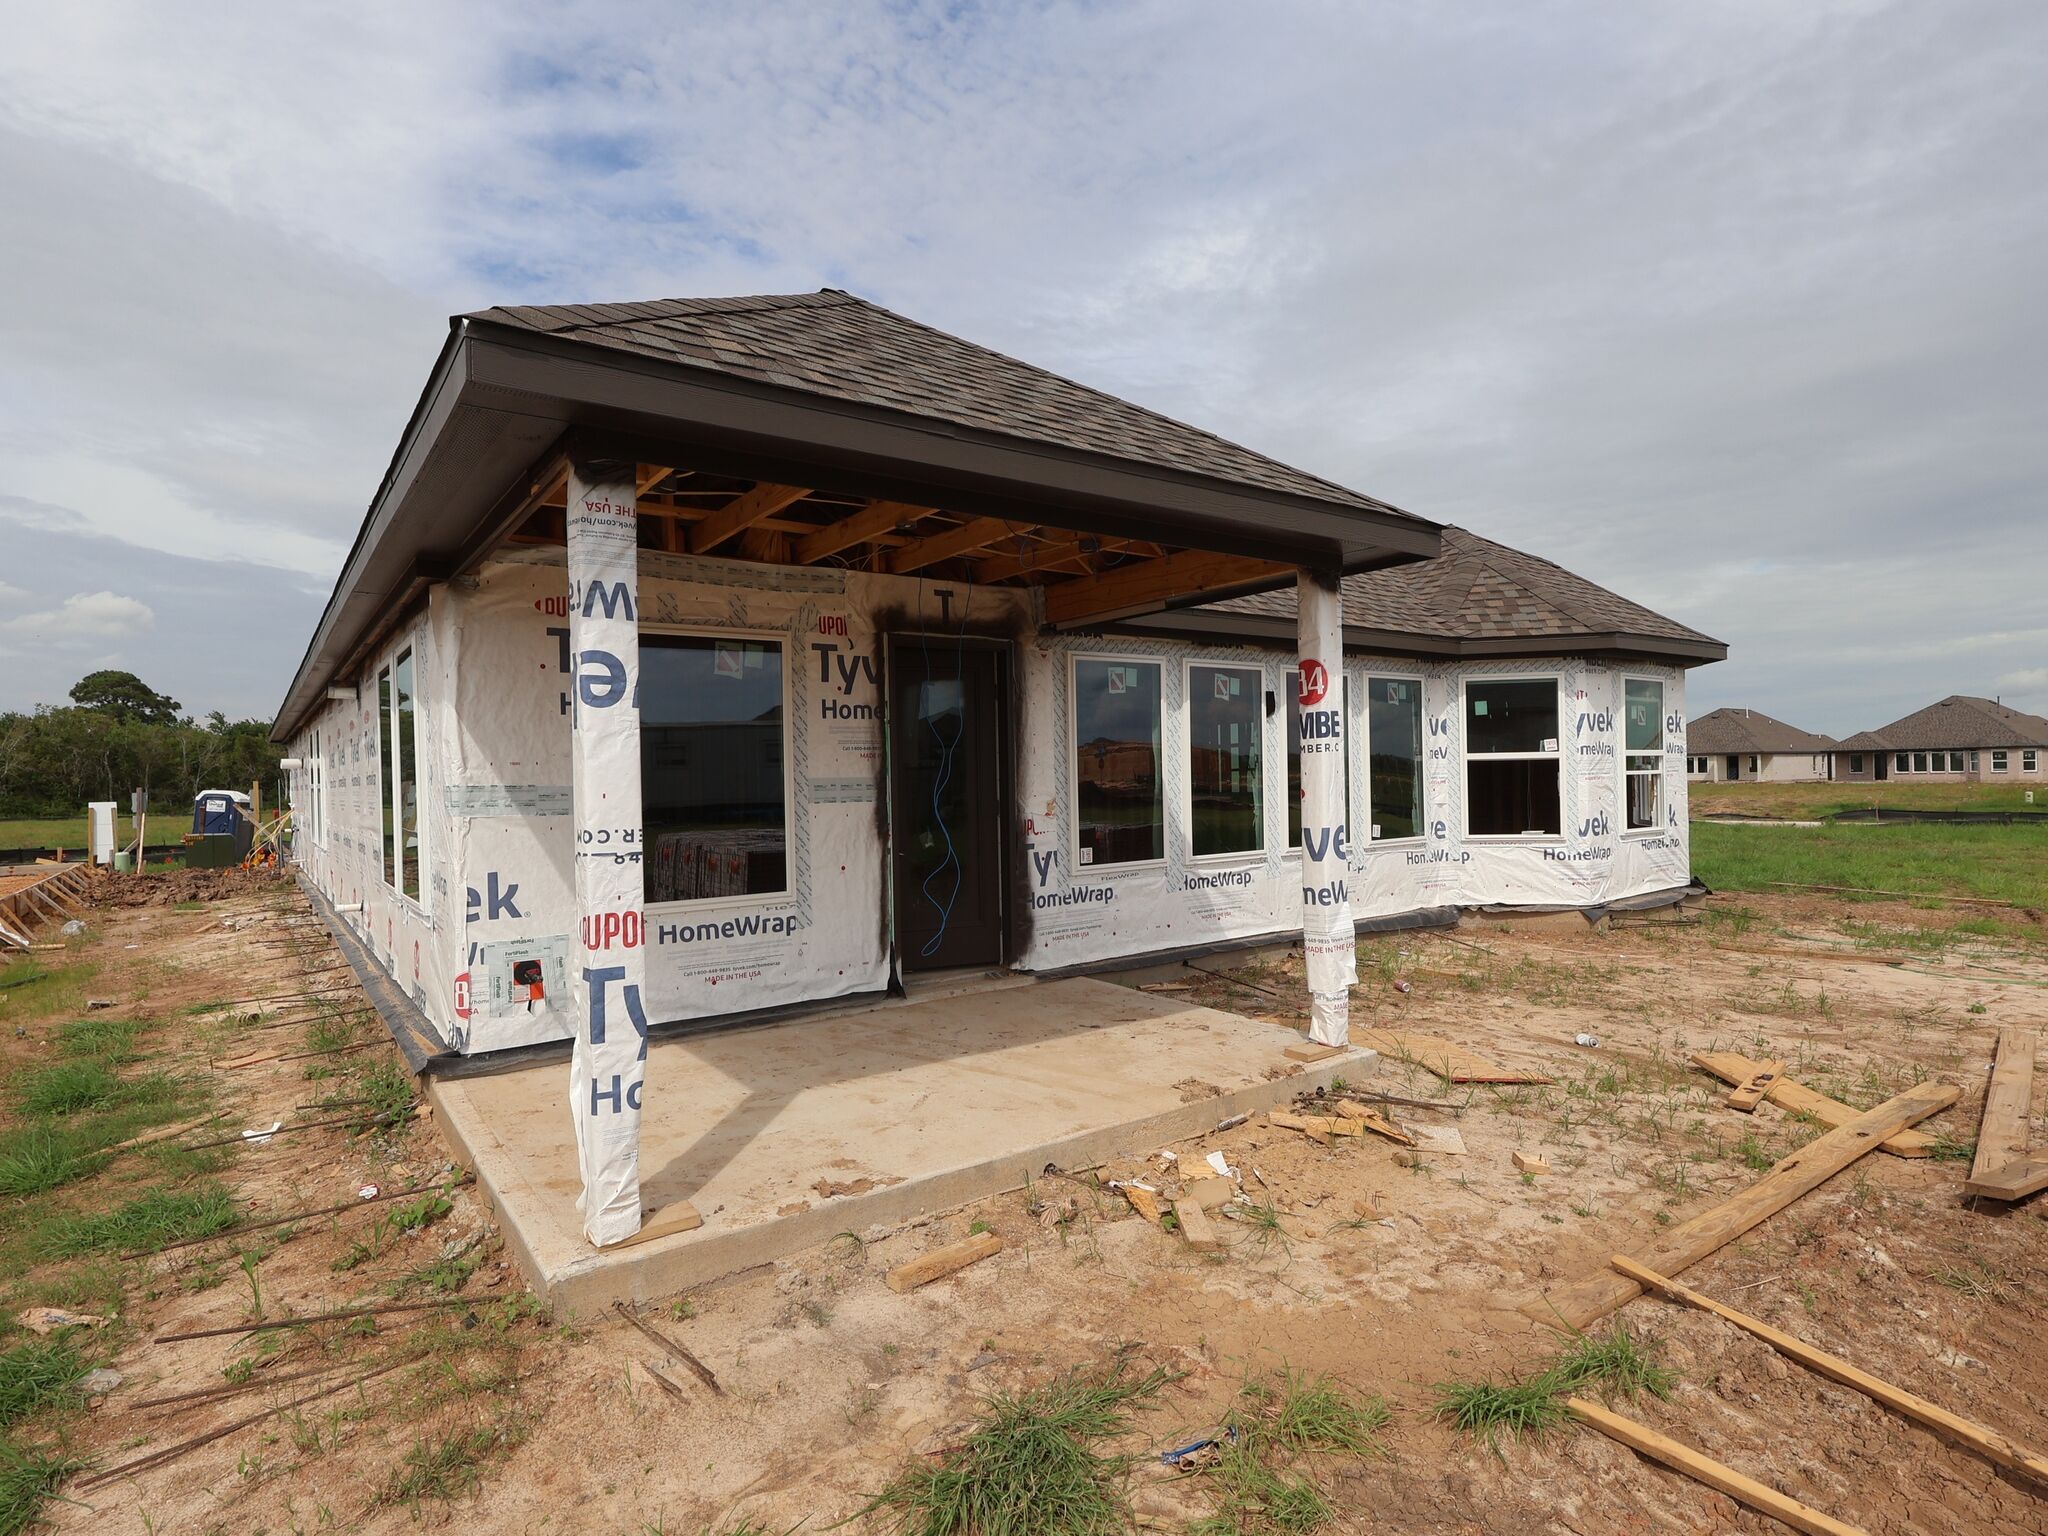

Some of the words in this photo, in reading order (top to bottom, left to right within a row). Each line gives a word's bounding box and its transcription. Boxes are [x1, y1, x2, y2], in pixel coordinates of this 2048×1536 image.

[585, 501, 611, 514] USA
[1666, 709, 1682, 733] ek
[658, 915, 797, 945] HomeWrap
[704, 975, 725, 983] MADE
[734, 972, 747, 980] THE
[749, 970, 762, 978] USA
